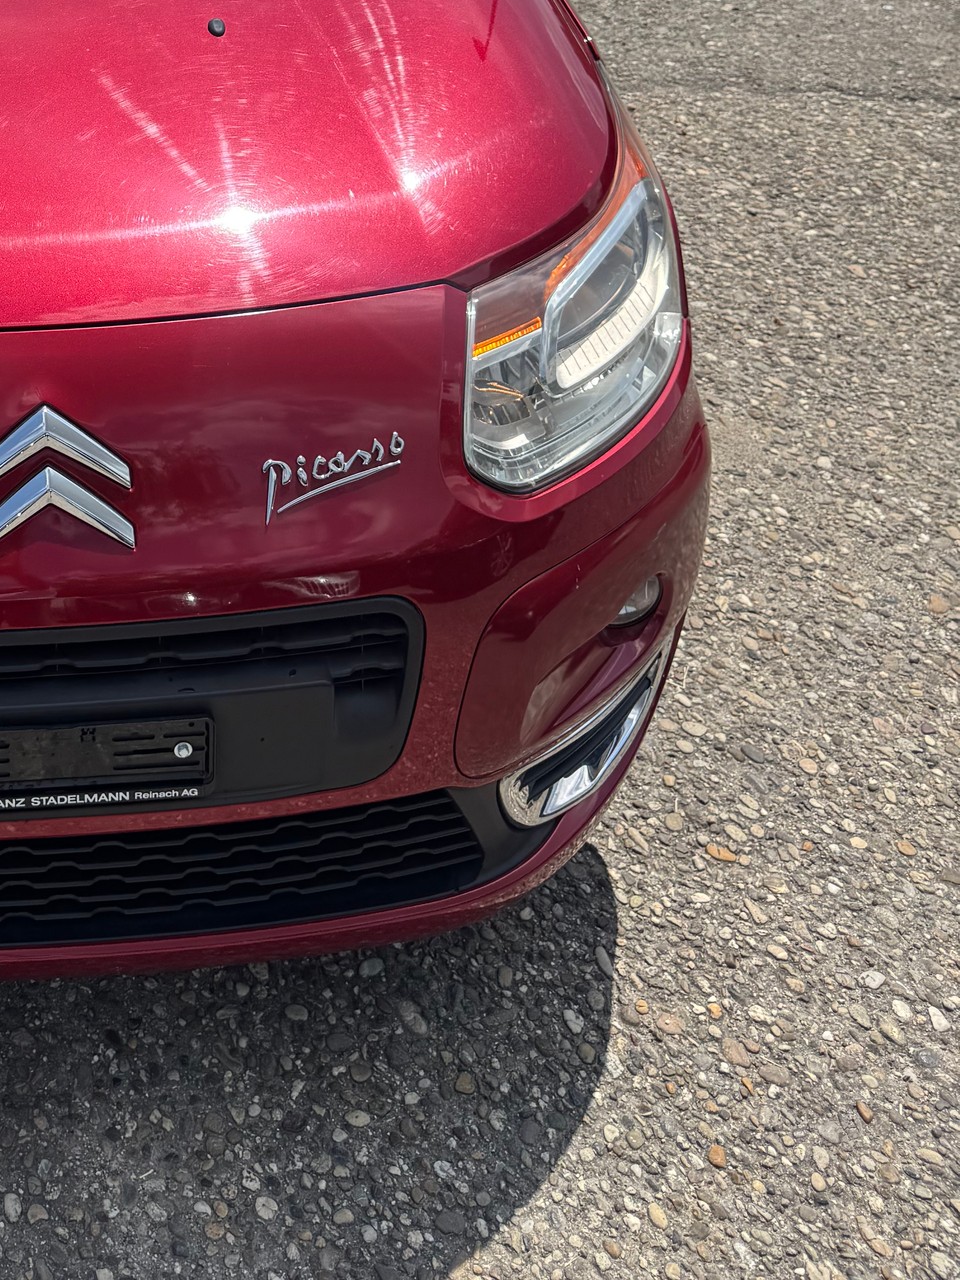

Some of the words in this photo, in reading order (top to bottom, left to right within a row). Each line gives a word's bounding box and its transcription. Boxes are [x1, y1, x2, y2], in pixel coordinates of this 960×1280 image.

[262, 431, 405, 526] Picasso
[30, 791, 130, 807] STADELMANN
[134, 789, 179, 800] Reinach
[181, 788, 198, 797] AG
